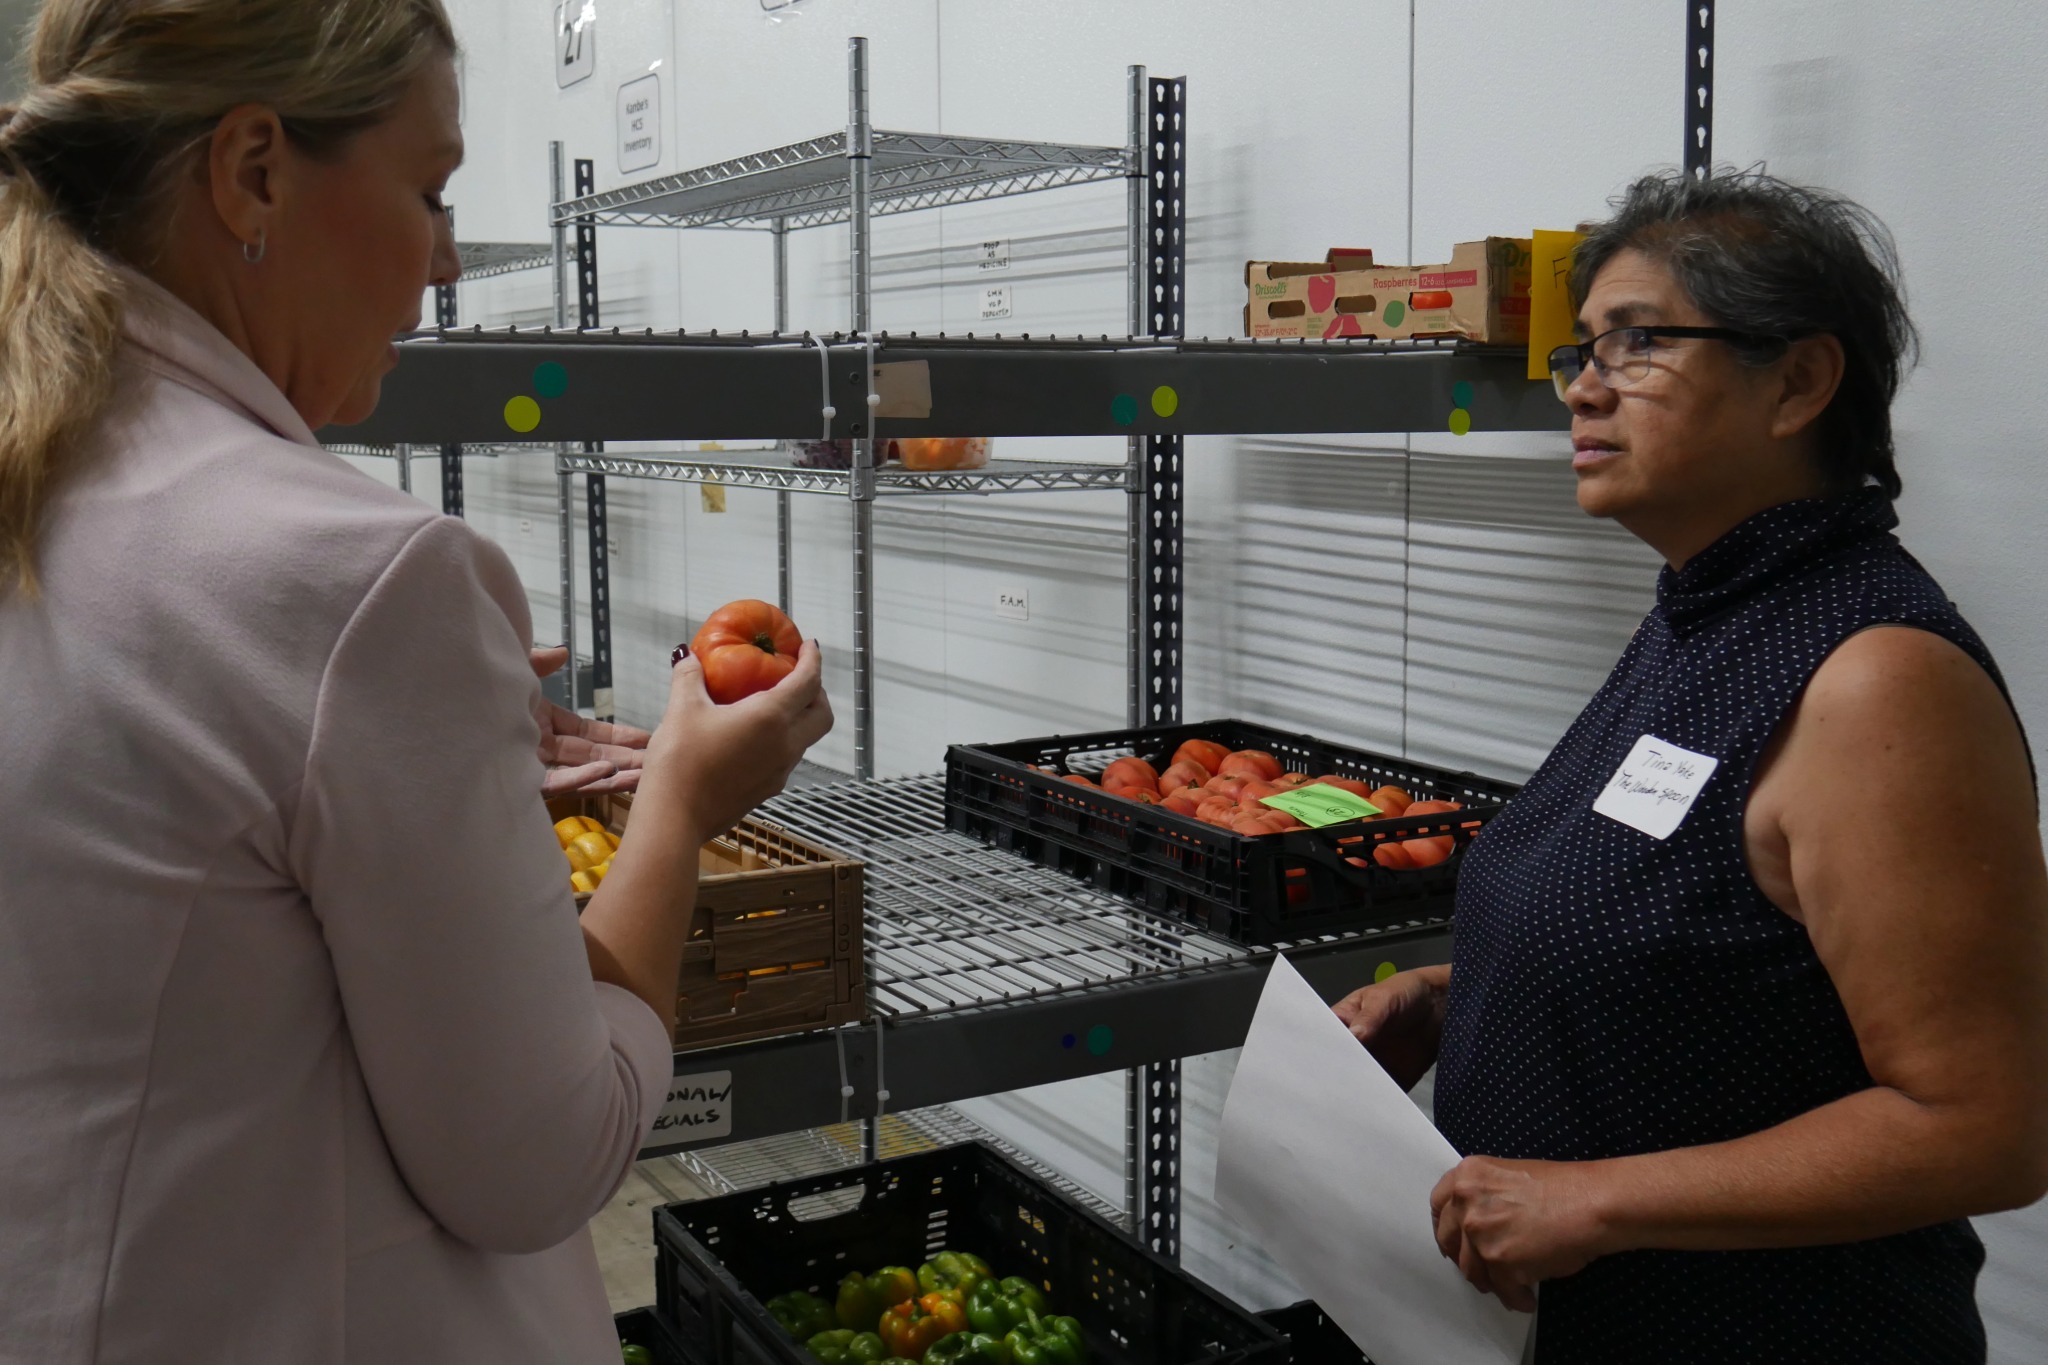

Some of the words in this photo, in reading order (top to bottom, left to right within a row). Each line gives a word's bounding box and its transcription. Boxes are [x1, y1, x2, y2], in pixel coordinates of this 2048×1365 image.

[564, 17, 583, 66] 27
[631, 118, 643, 132] HCS
[624, 136, 652, 153] Inventory
[988, 250, 996, 258] AS
[1255, 281, 1287, 296] Driscoll's
[1441, 277, 1473, 286] CAMSHELLS
